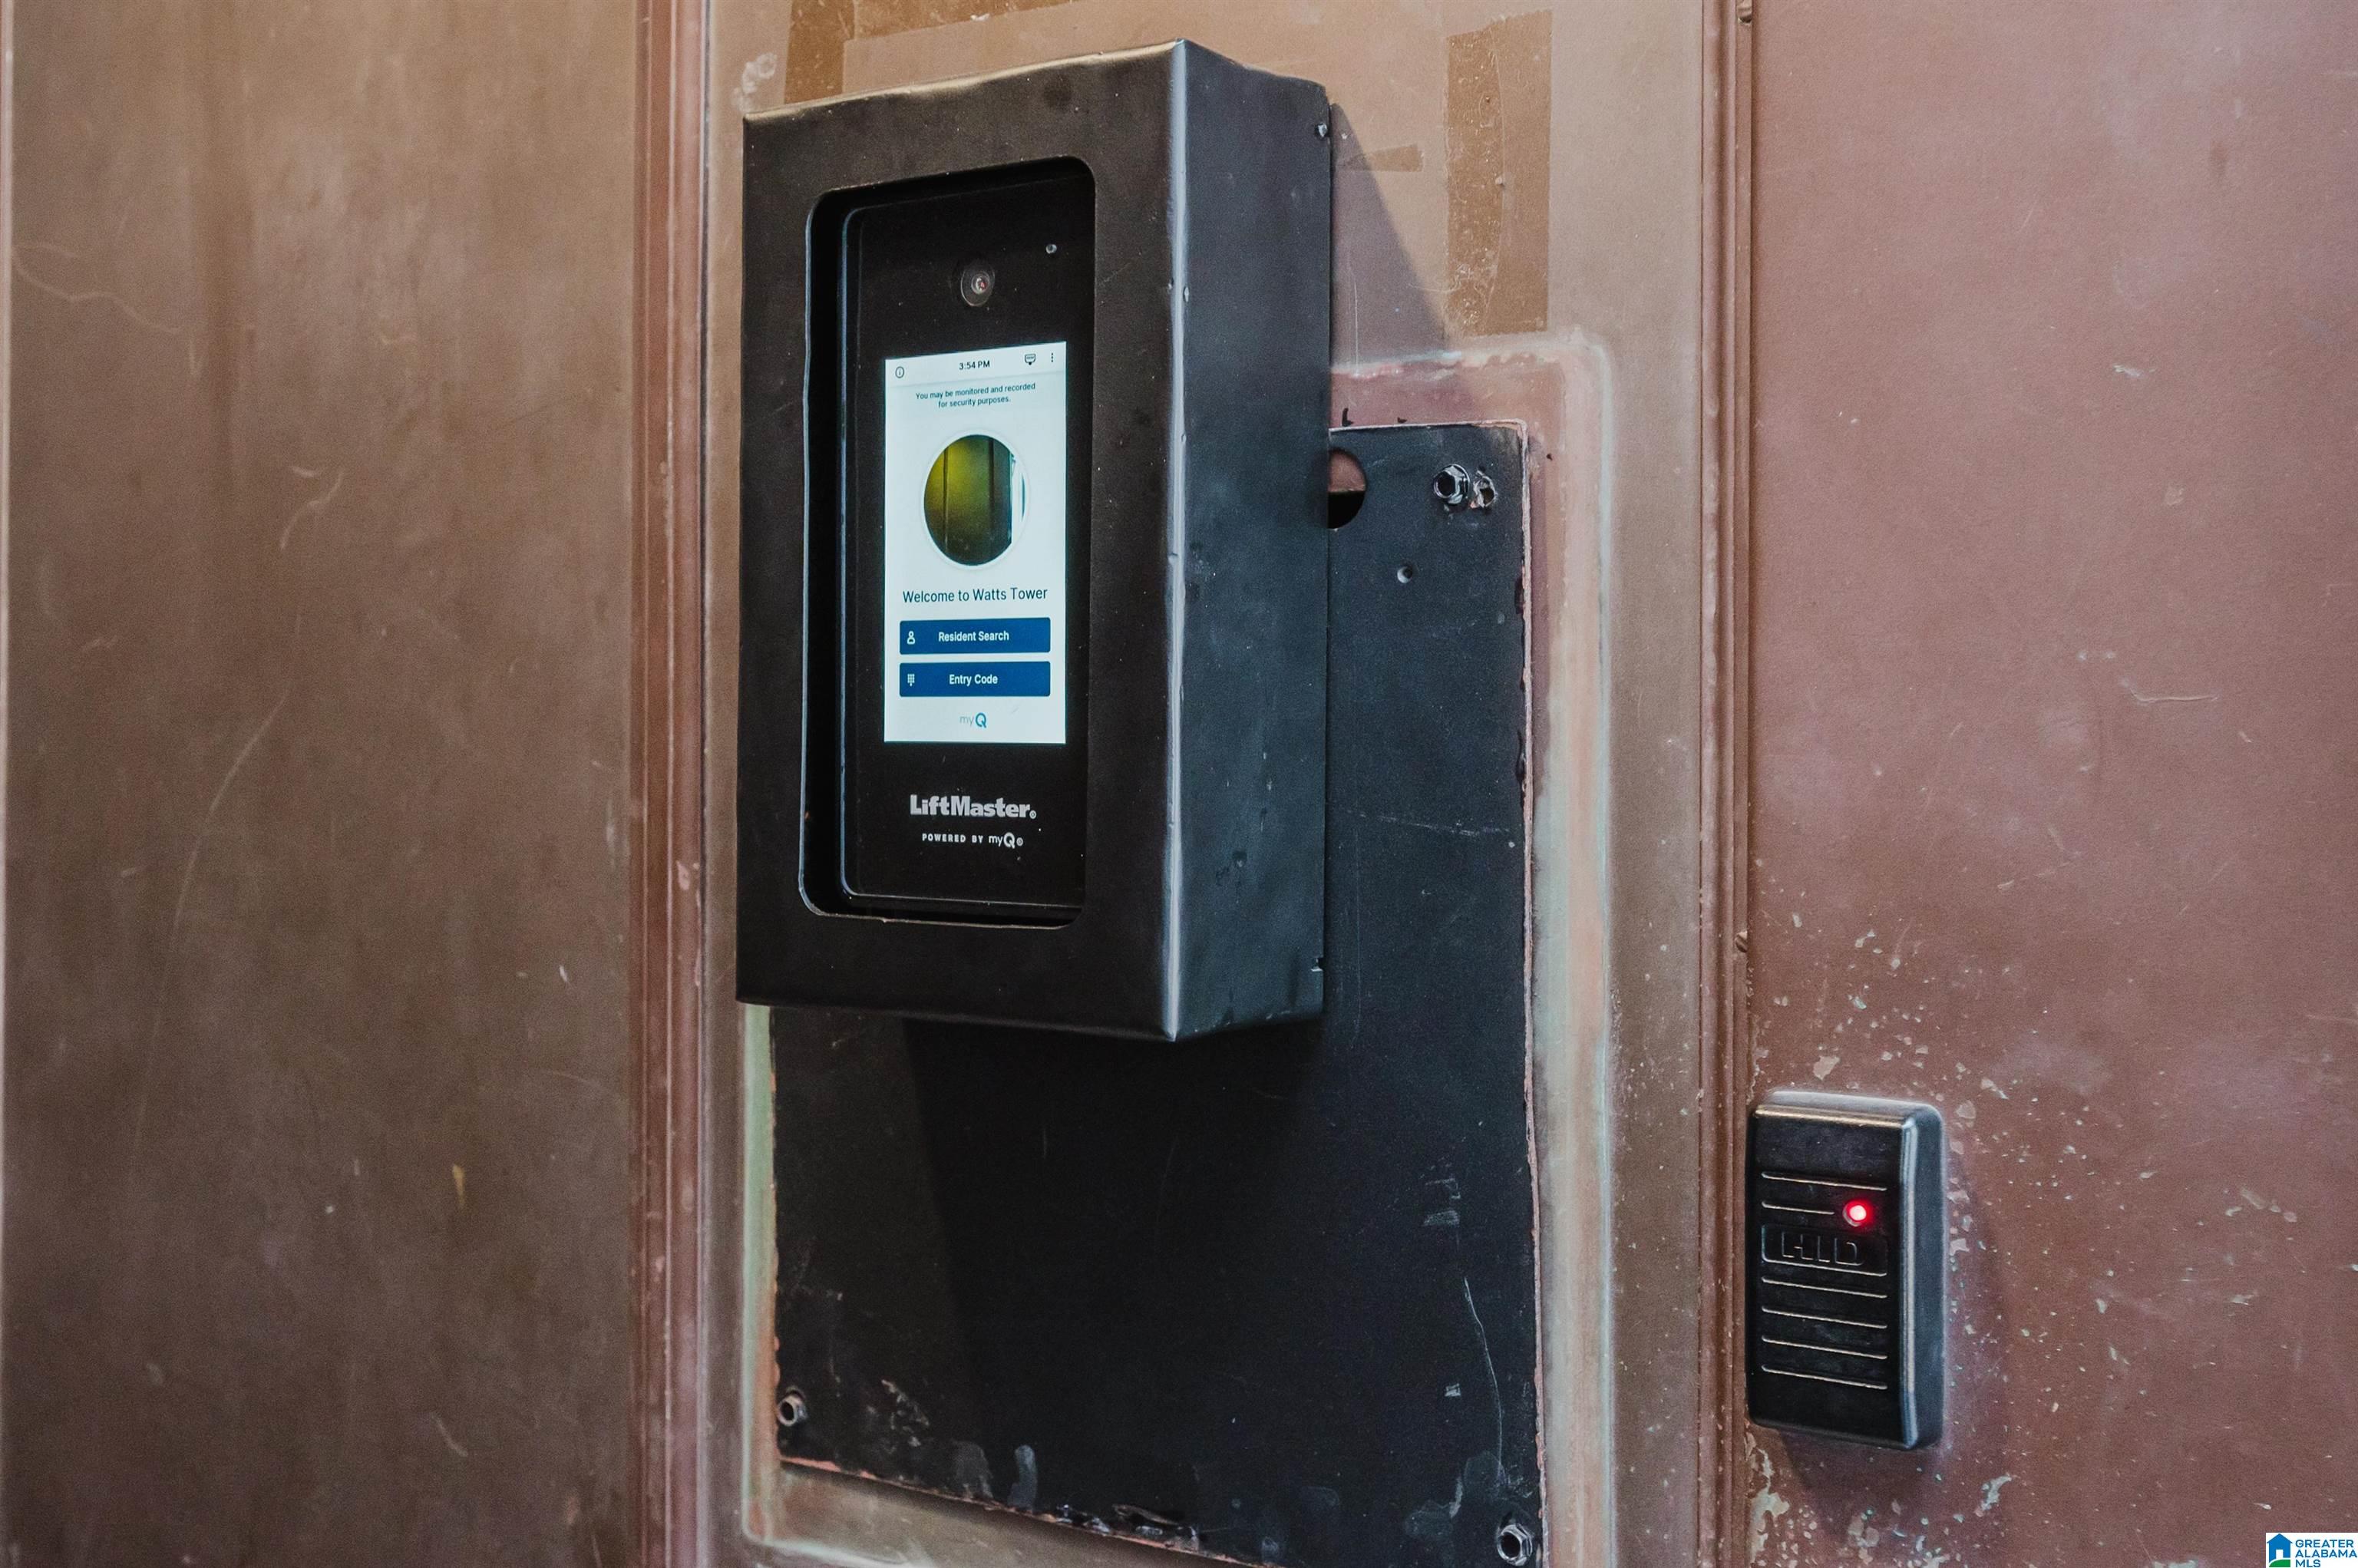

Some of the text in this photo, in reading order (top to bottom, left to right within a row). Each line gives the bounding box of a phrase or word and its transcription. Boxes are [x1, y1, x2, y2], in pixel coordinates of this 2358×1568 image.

[959, 360, 991, 370] 3:54 PM
[915, 391, 929, 401] You
[930, 391, 944, 400] may
[955, 387, 989, 396] monitored
[1004, 383, 1036, 392] recorded
[938, 396, 1012, 409] for security purposes.
[903, 586, 1049, 603] Welcome to Watts Tower
[938, 630, 1010, 642] Resident Search
[949, 674, 999, 686] Entry Code
[959, 712, 987, 728] myQ
[922, 833, 966, 843] POWERED
[972, 834, 983, 843] BY
